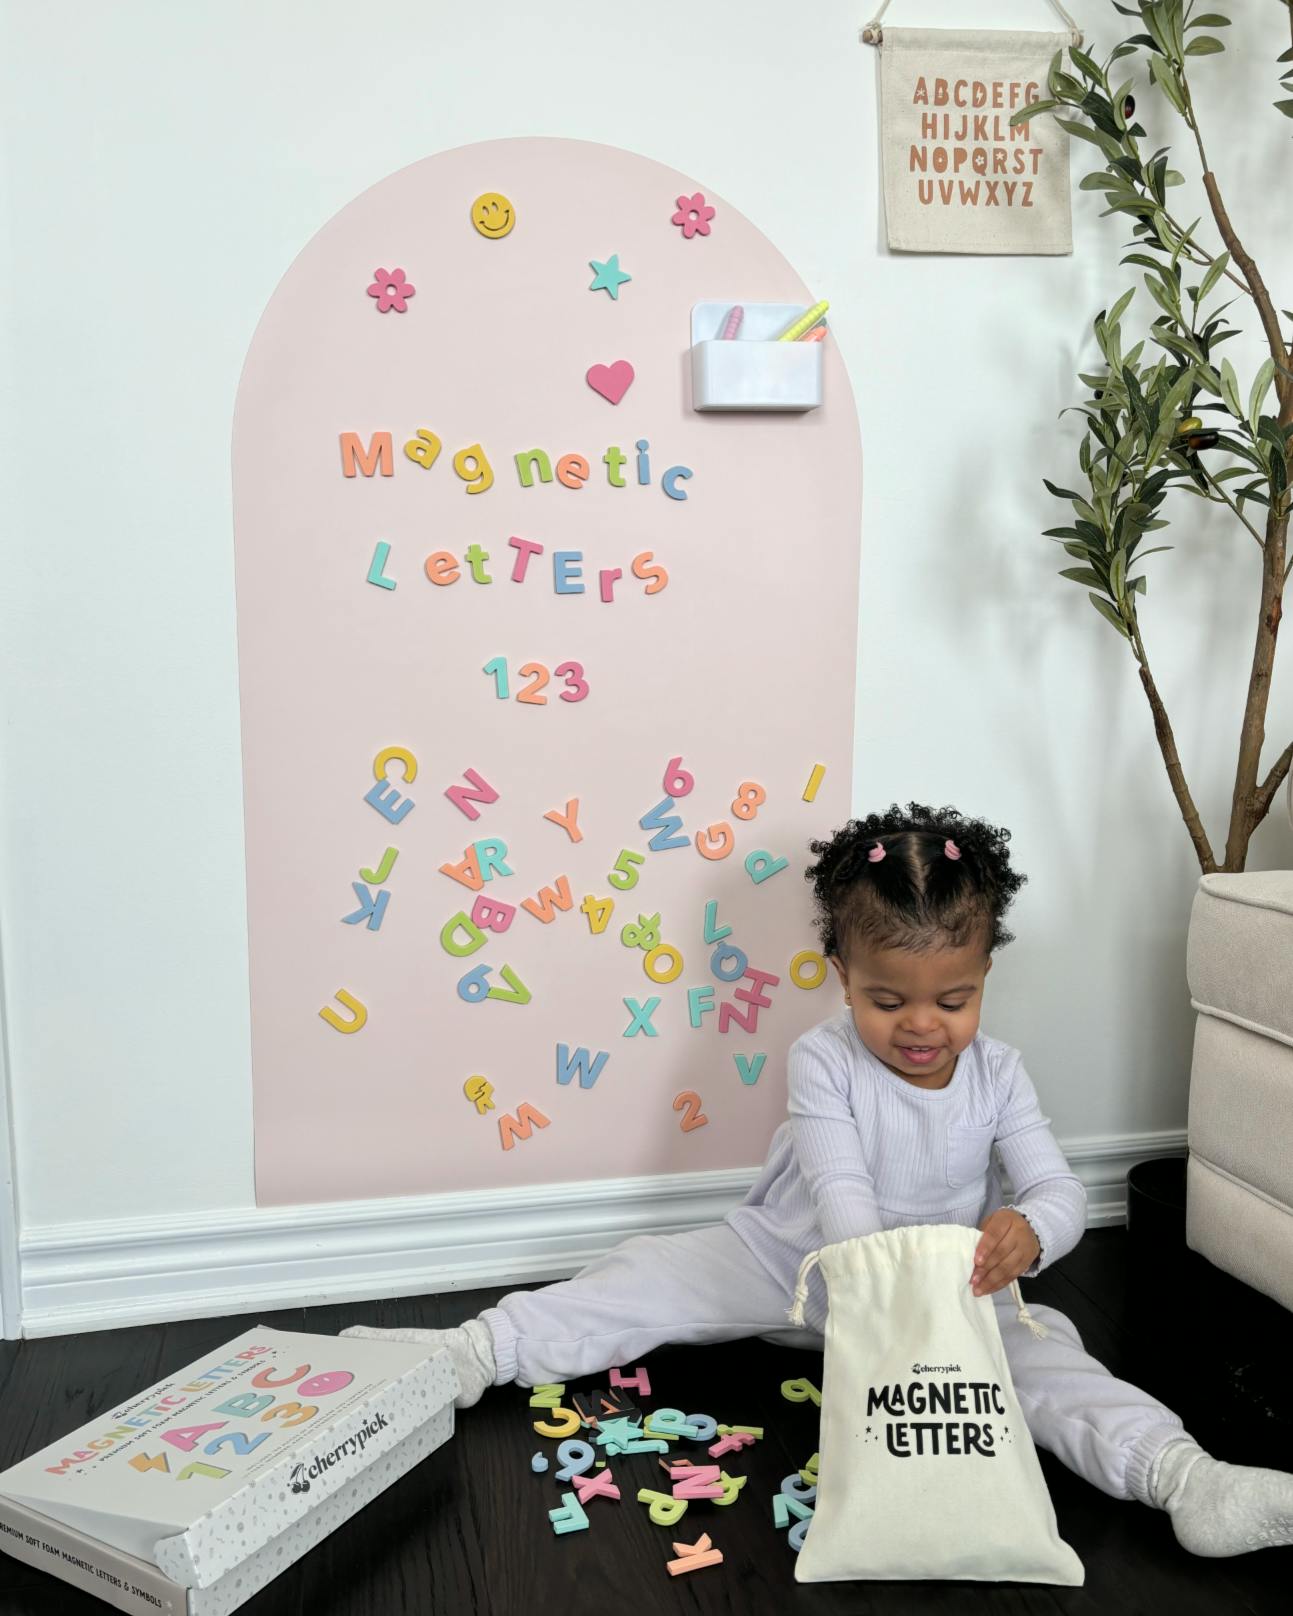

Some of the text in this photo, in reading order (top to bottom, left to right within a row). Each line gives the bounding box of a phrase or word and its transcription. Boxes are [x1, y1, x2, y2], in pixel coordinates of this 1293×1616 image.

[912, 76, 1040, 109] ABCDEFG
[921, 112, 1030, 142] HIJKLM
[909, 144, 1044, 177] NOPQRST
[918, 179, 1034, 207] UVWXYZ
[339, 428, 693, 501] Magnetic
[483, 656, 590, 705] 123
[920, 1363, 962, 1375] cherrypick
[44, 1394, 187, 1476] MAGNETIC
[180, 1345, 273, 1393] LETTERS
[866, 1381, 1006, 1417] MAGNETIC
[307, 1411, 389, 1480] cherrypick
[886, 1422, 996, 1458] LETTERS
[25, 1534, 41, 1549] SOFT
[42, 1542, 61, 1558] FOAM
[62, 1551, 95, 1575] MAGNETIC
[95, 1567, 122, 1589] LETTERS
[131, 1585, 163, 1609] SYMBOLS
